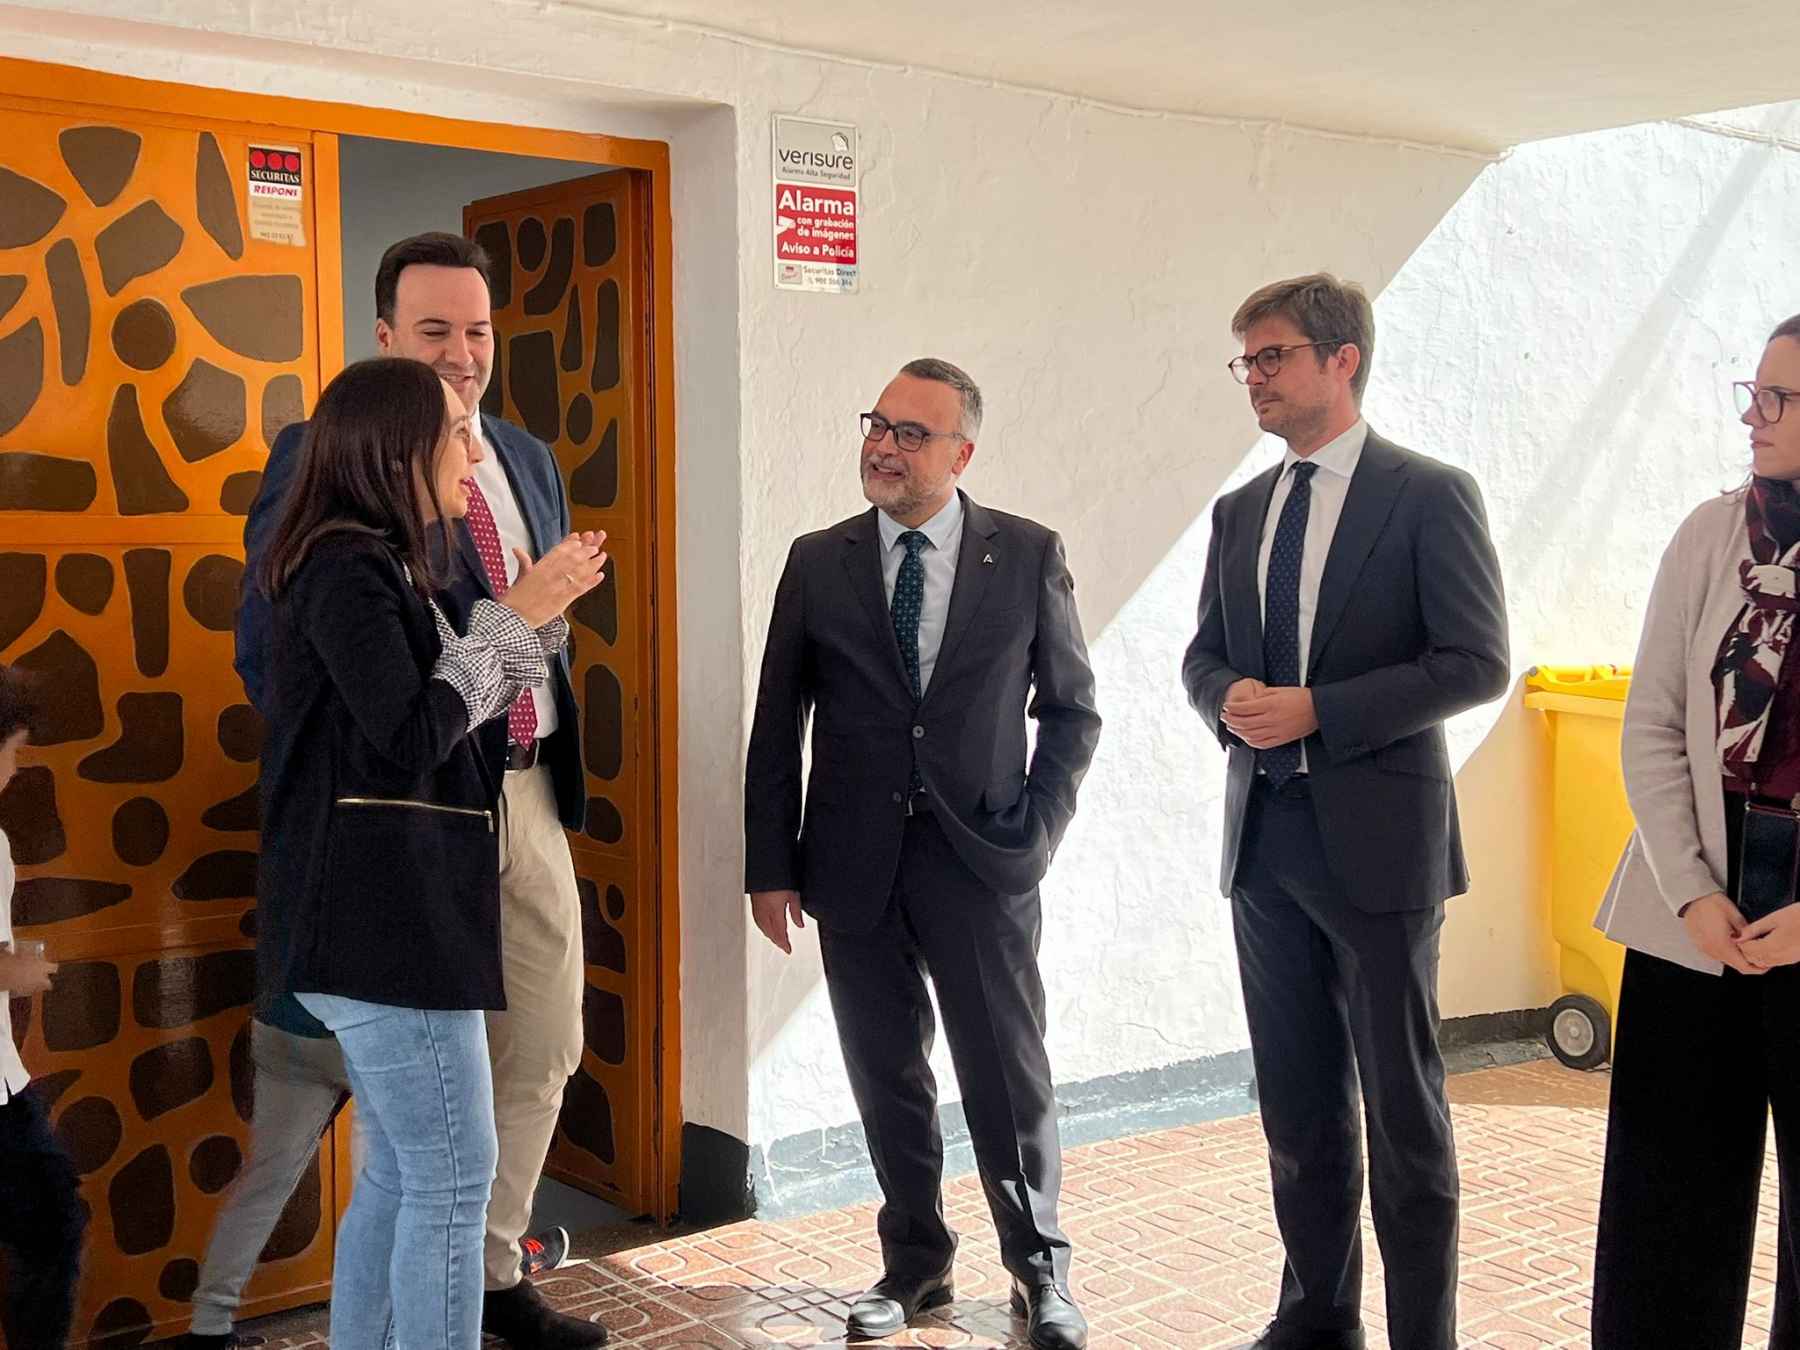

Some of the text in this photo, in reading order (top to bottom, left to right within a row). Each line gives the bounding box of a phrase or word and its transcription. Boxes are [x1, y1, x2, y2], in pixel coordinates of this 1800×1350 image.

[779, 149, 853, 169] verisure
[251, 170, 299, 182] SECURITAS
[778, 189, 854, 215] Alarma
[797, 217, 854, 228] con grabación
[797, 226, 854, 241] de imágenes
[782, 241, 854, 257] Aviso a Policía
